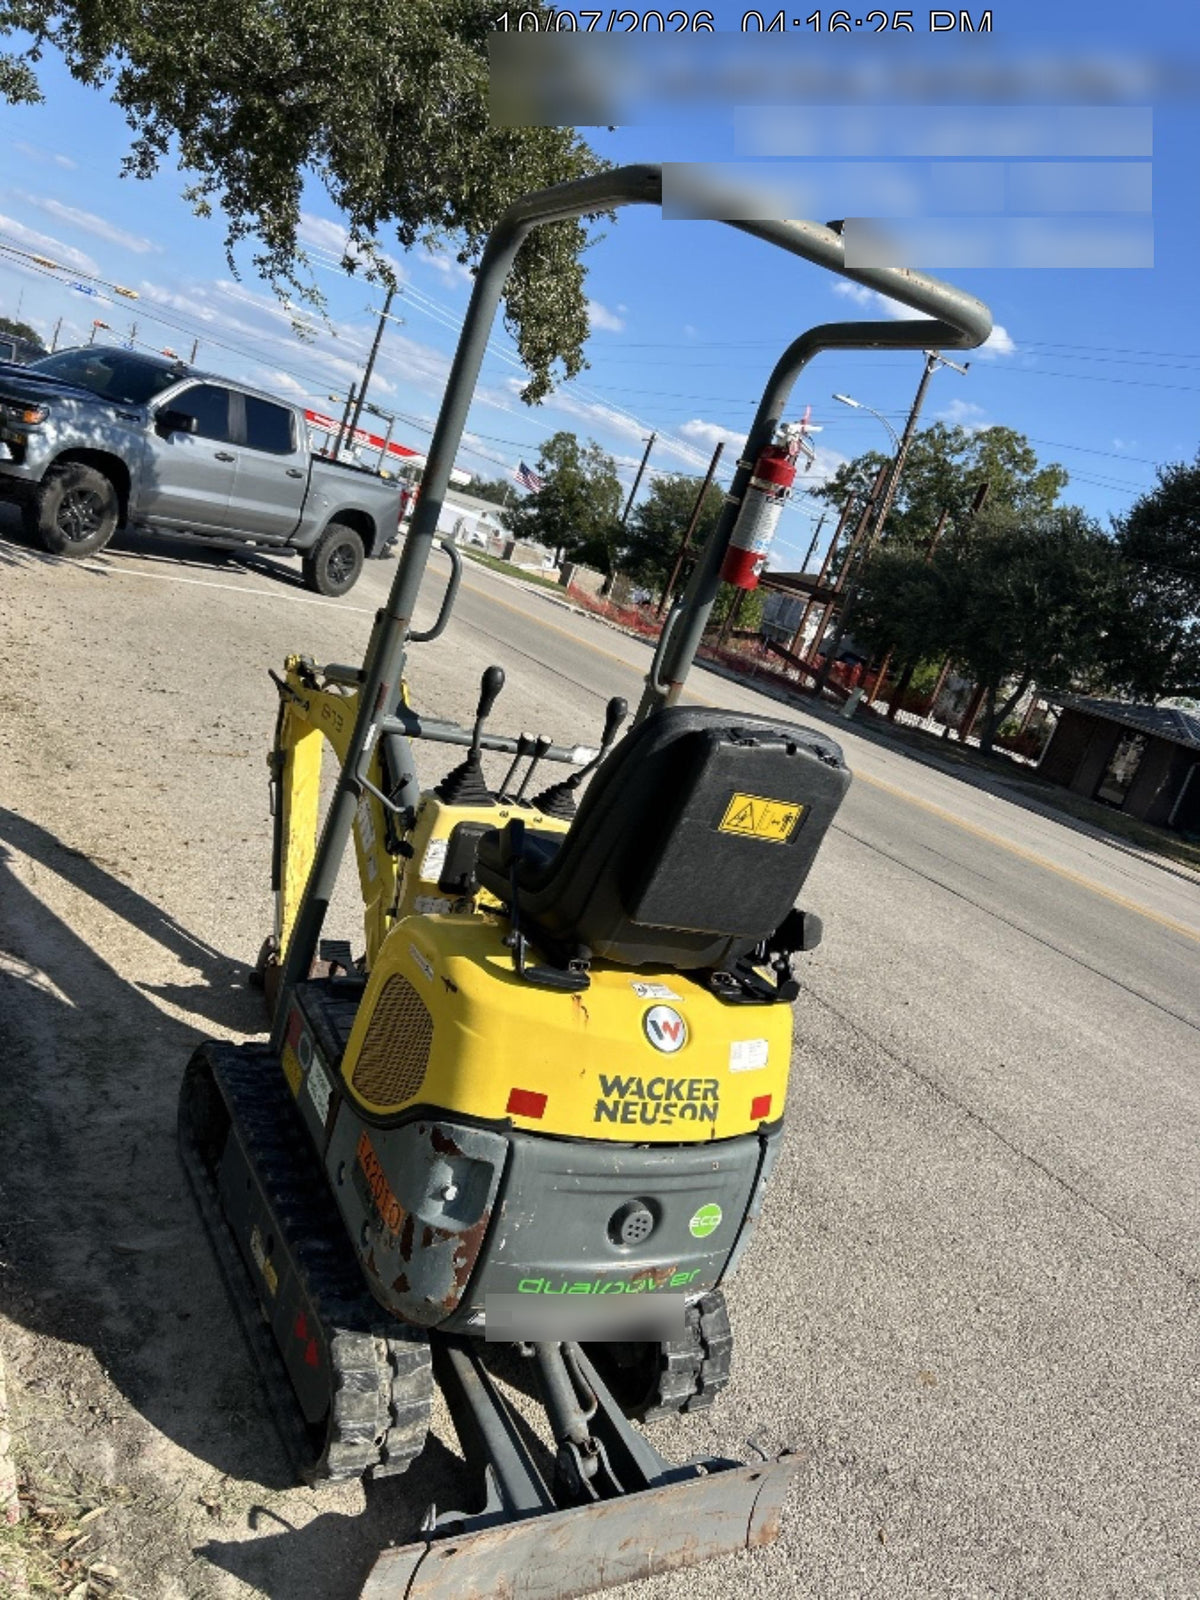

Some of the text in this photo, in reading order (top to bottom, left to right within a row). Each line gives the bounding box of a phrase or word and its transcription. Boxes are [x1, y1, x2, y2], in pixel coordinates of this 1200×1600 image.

[599, 1074, 720, 1101] WACKER
[594, 1099, 719, 1125] NEUSON
[689, 1215, 721, 1227] ECO
